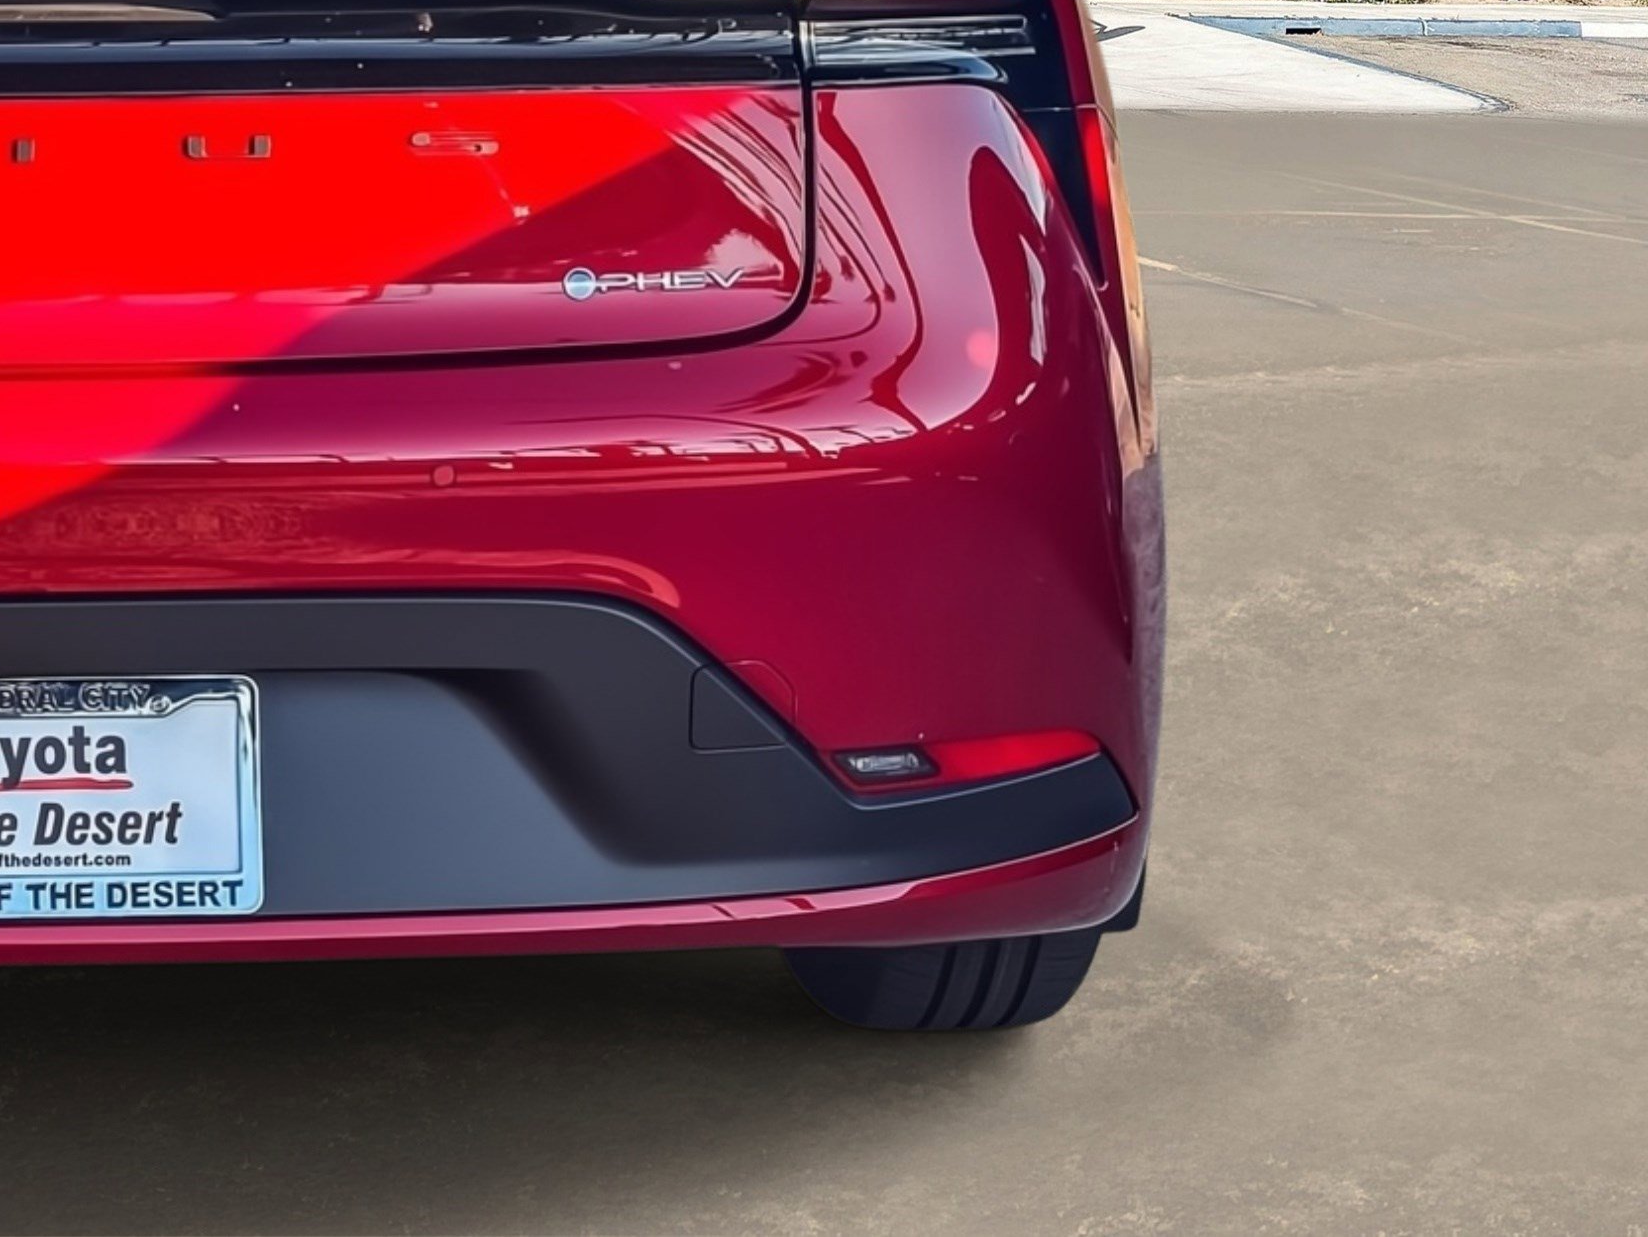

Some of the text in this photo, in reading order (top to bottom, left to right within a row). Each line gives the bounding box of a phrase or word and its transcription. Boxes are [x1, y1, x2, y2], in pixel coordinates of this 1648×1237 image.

[597, 267, 745, 292] PHEV
[79, 681, 151, 712] CITY
[33, 801, 183, 846] Desert
[26, 881, 96, 910] THE
[106, 879, 244, 909] DESERT
